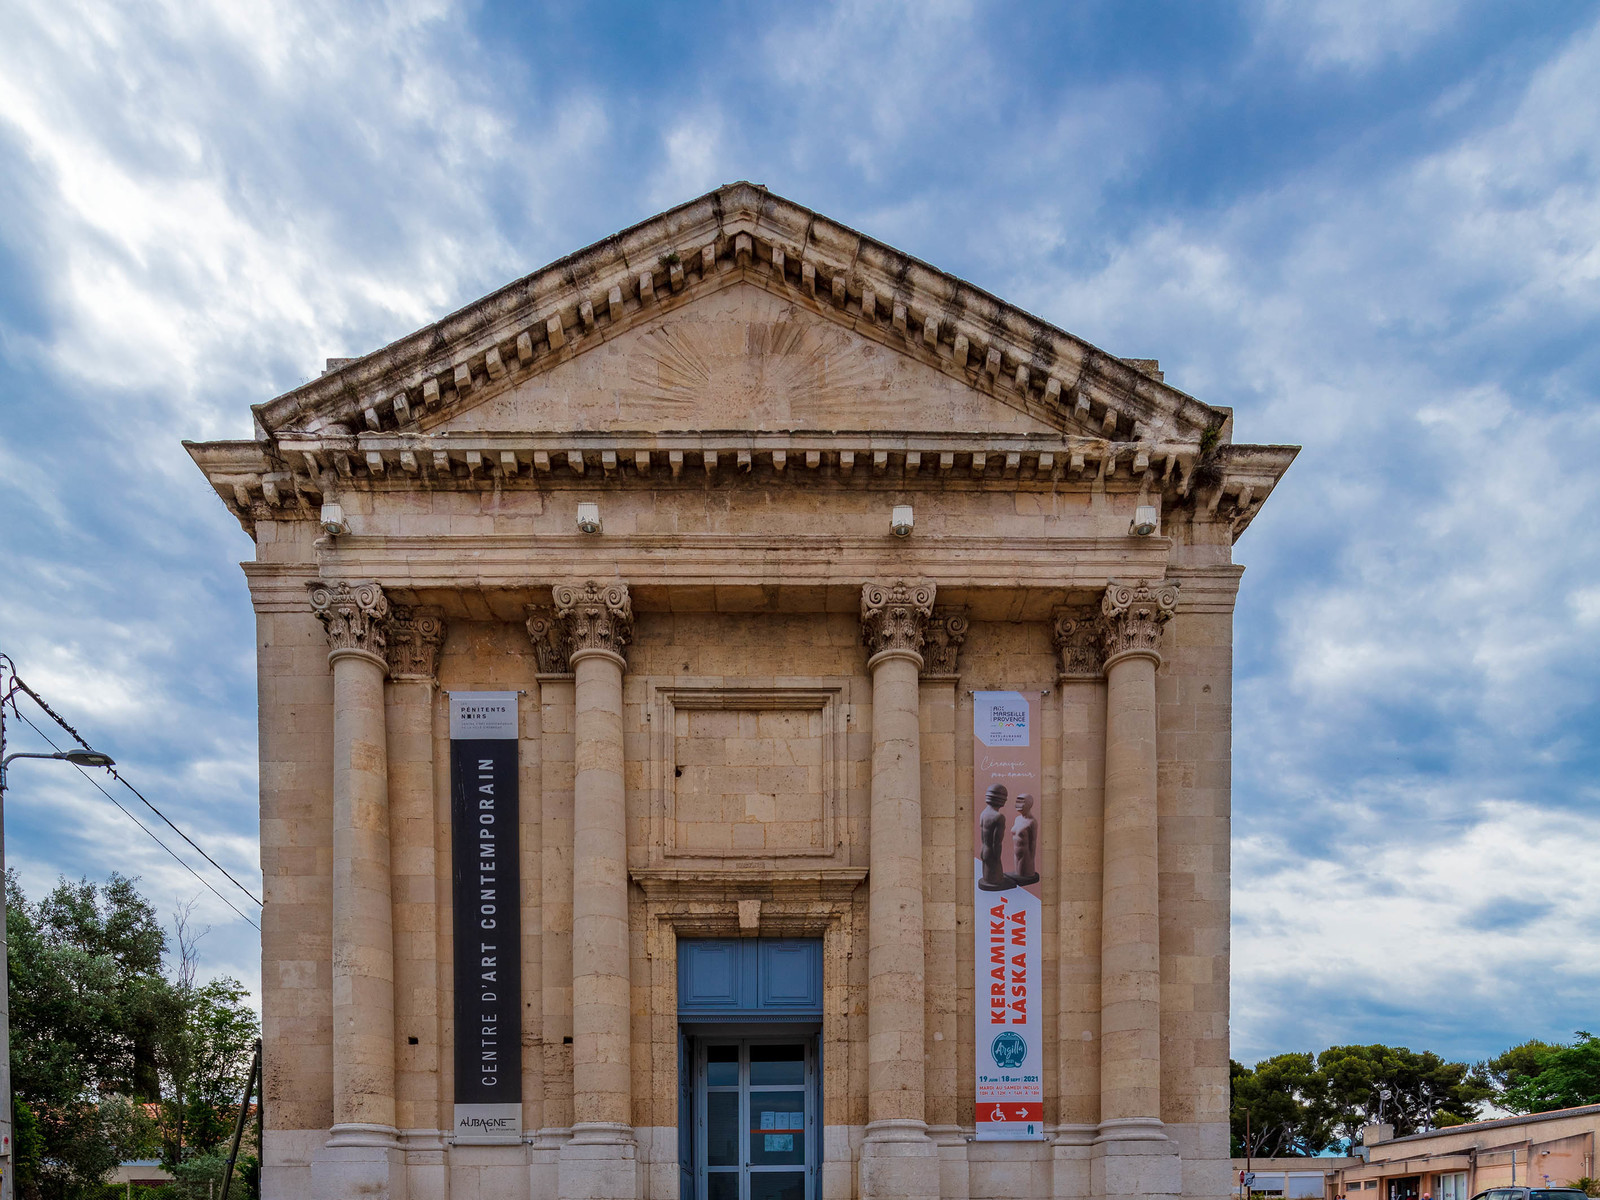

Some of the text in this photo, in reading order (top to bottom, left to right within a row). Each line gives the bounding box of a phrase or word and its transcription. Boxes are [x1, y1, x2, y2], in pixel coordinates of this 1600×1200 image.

[478, 759, 498, 1086] CENTRE D'ART CONTEMPORAIN
[990, 896, 1008, 1024] KERAMIKA,
[1006, 910, 1026, 1024] LÁSKA MÁ
[460, 1116, 516, 1132] AUBAGNE
